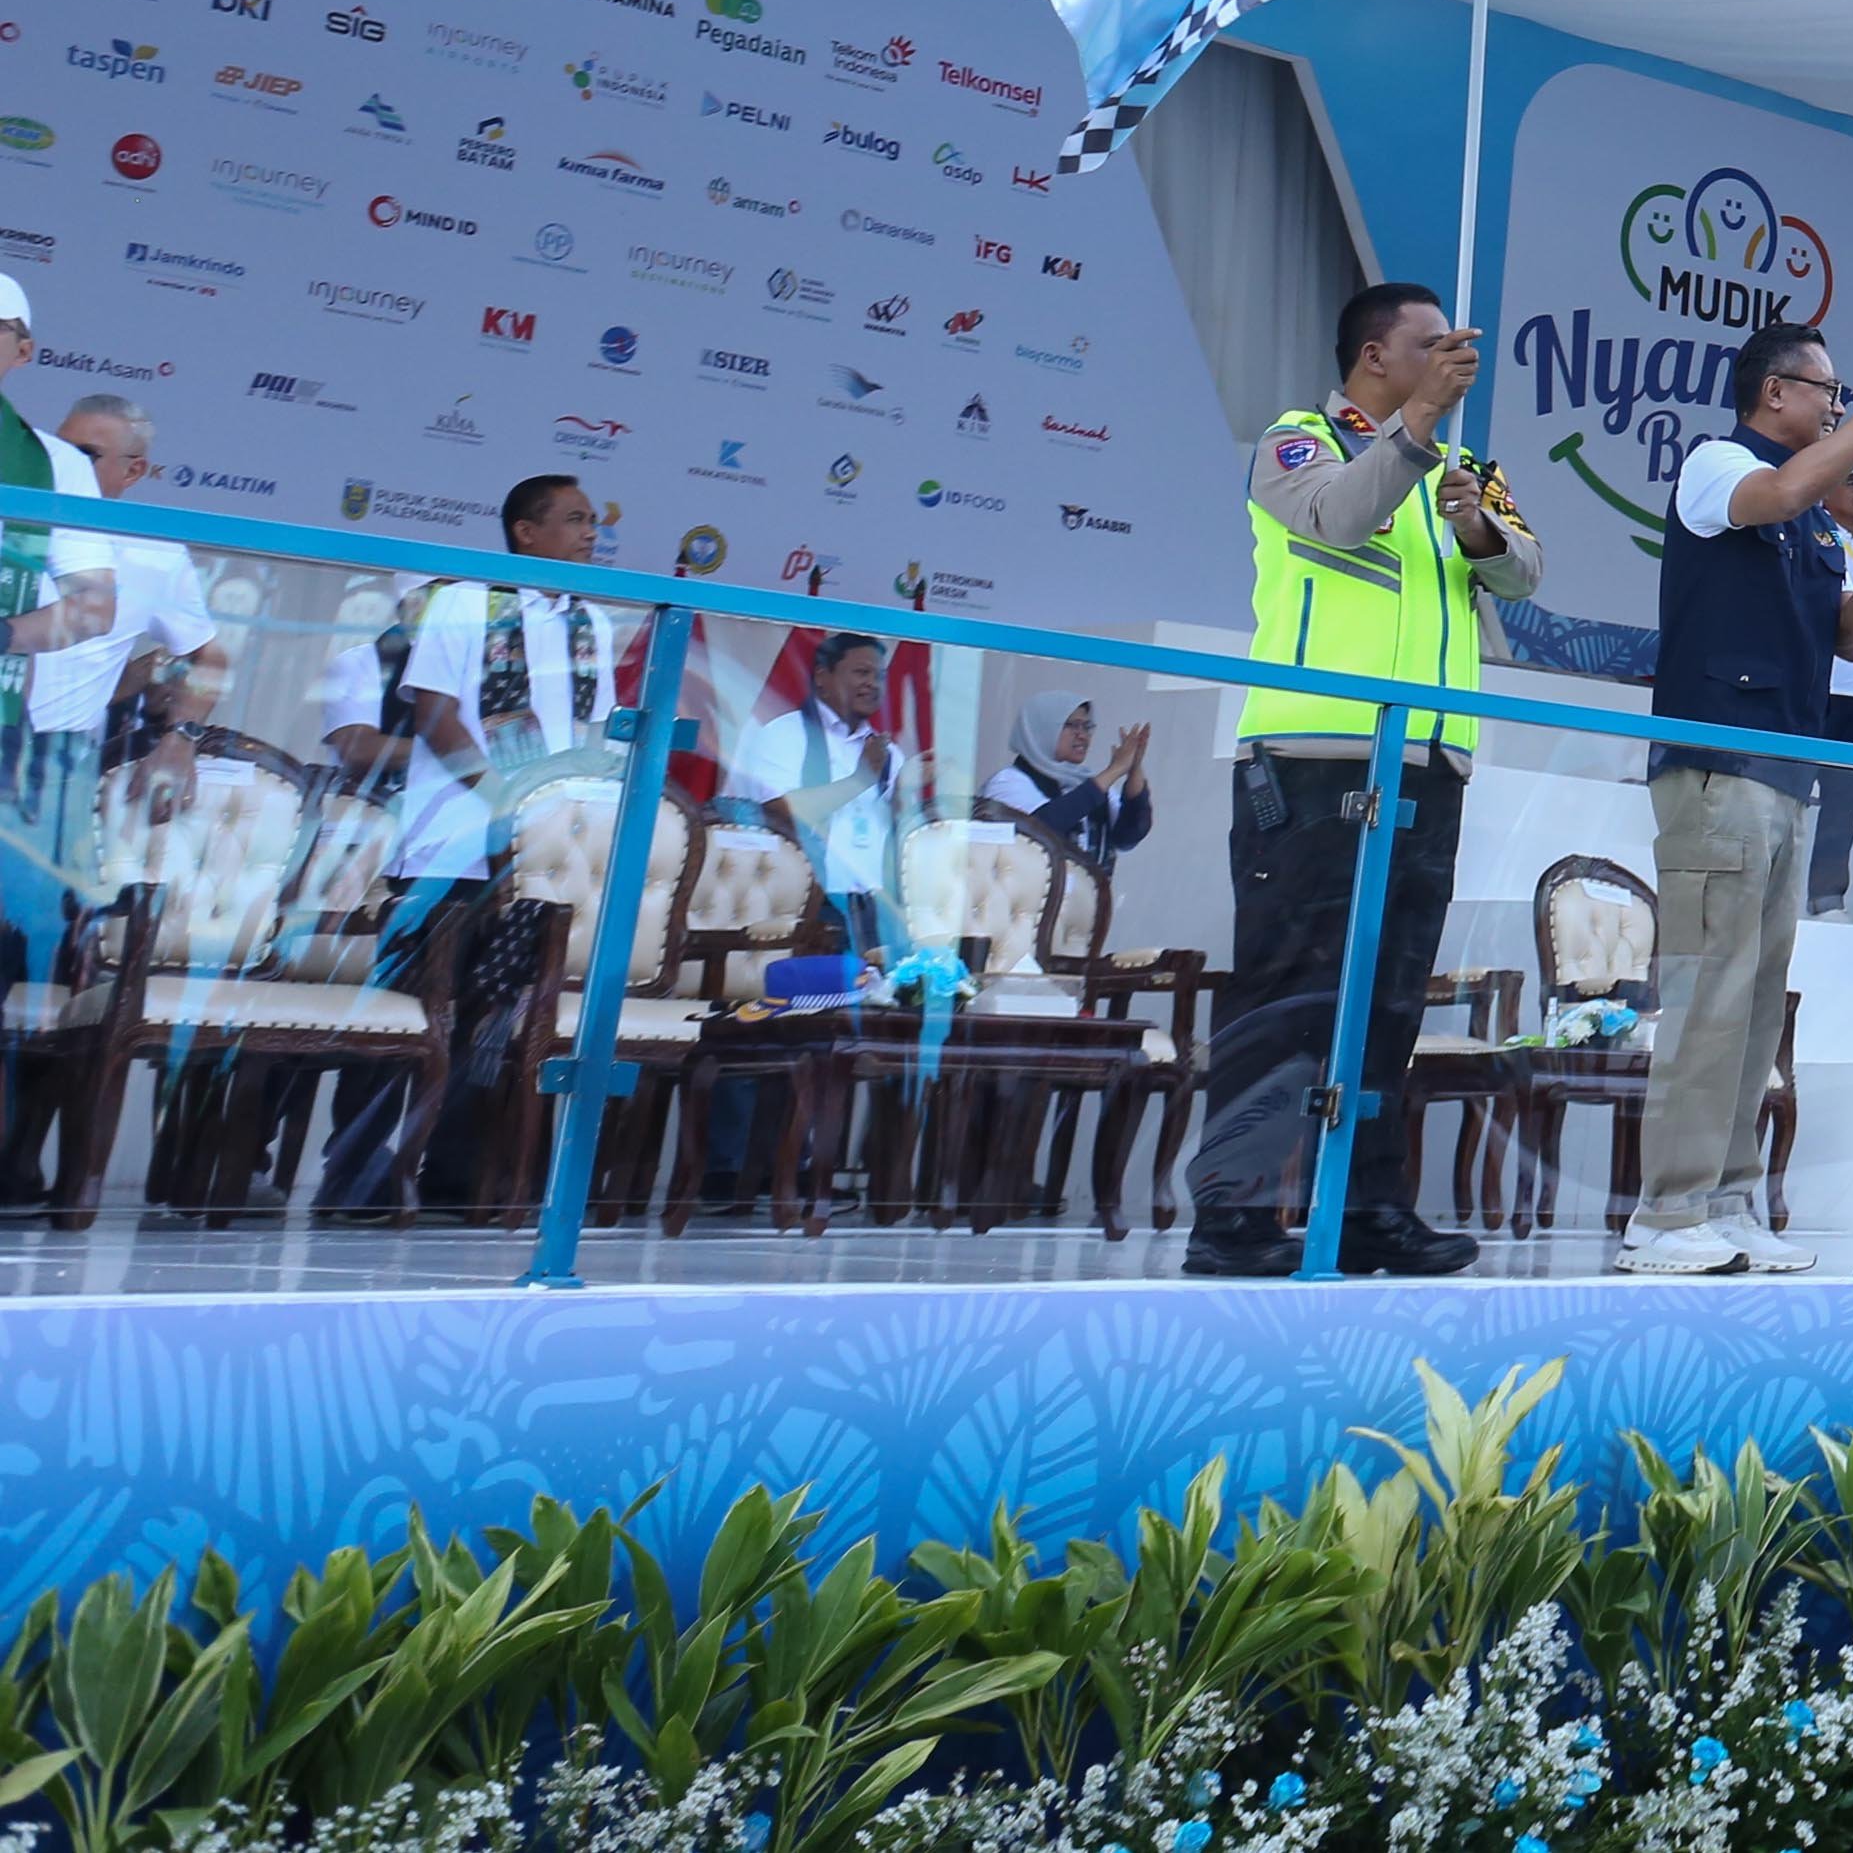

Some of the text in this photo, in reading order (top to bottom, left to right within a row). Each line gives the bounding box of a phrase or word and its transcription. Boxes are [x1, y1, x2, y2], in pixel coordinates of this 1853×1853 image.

[324, 8, 387, 43] SIG
[696, 18, 806, 66] Pegadaian
[830, 40, 877, 64] Telkom
[67, 44, 165, 84] taspen
[832, 56, 898, 83] Indonesia
[938, 60, 1043, 107] Telkomsel
[726, 102, 791, 131] PELNI
[841, 125, 900, 161] bulog
[457, 148, 515, 172] BATAM
[557, 156, 665, 193] kimia farma
[942, 164, 983, 187] asdp
[211, 158, 331, 198] injourney
[404, 208, 478, 236] MIND ID
[150, 247, 246, 278] Jamkrindo
[627, 245, 735, 285] injourney
[308, 279, 427, 320] injourney
[1659, 266, 1791, 331] MUDIK
[38, 348, 154, 382] Bukit Asam
[713, 351, 771, 377] SIER
[199, 470, 277, 496] KALTIM
[945, 489, 1005, 513] ID FOOD
[1085, 514, 1132, 535] ASABRI
